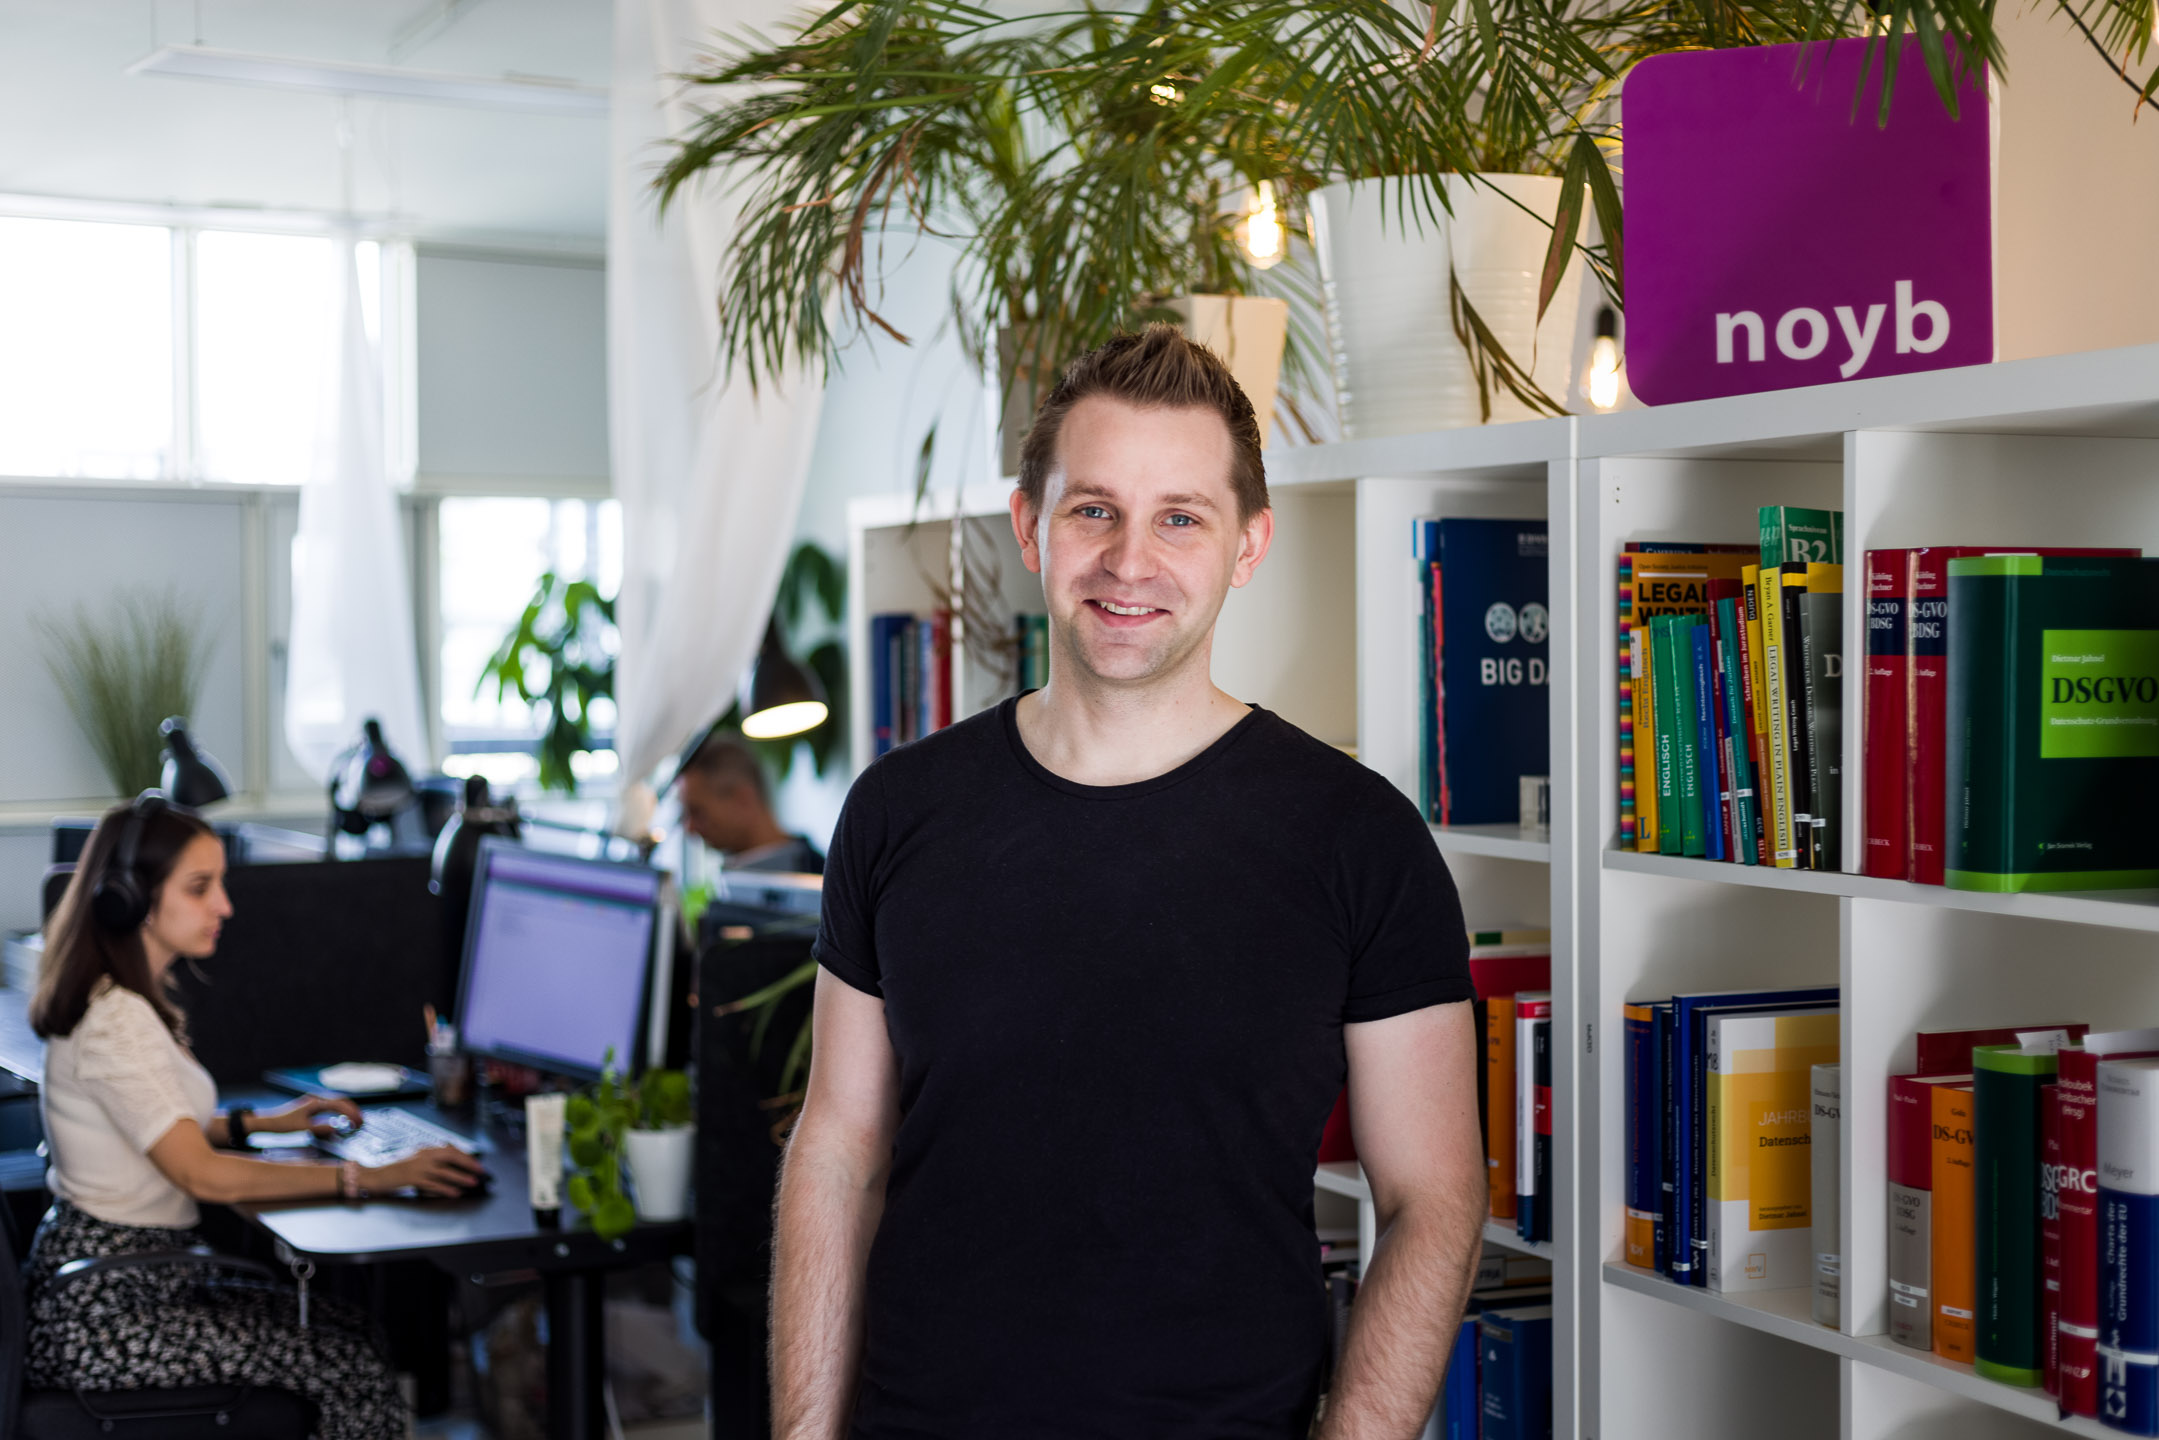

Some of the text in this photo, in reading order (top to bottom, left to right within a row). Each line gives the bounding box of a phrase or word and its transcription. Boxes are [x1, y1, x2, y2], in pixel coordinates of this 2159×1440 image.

[1715, 280, 1951, 379] noyb
[1790, 538, 1829, 563] B2
[1638, 582, 1708, 603] LEGAL
[1747, 590, 1755, 620] DUDEN
[1764, 576, 1775, 641] Bryan A. Garner
[1870, 617, 1893, 629] BDSG
[1911, 622, 1941, 638] BDSG
[1737, 606, 1752, 702] Schreiben im Jurastudium
[1480, 658, 1523, 686] BIG
[2051, 676, 2158, 704] DSGVO
[1769, 649, 1787, 847] LEGAL WRITING IN PLAIN ENGLISH
[1661, 734, 1671, 797] ENGLISCH
[1685, 743, 1695, 797] ENGLISCH
[2061, 1105, 2085, 1120] (Hrsg)
[1759, 1132, 1812, 1148] Datensch
[2058, 1165, 2097, 1193] GRC
[2103, 1161, 2134, 1181] Meyer
[2106, 1200, 2116, 1264] Charta der
[2117, 1203, 2127, 1320] Grundrechte der EU
